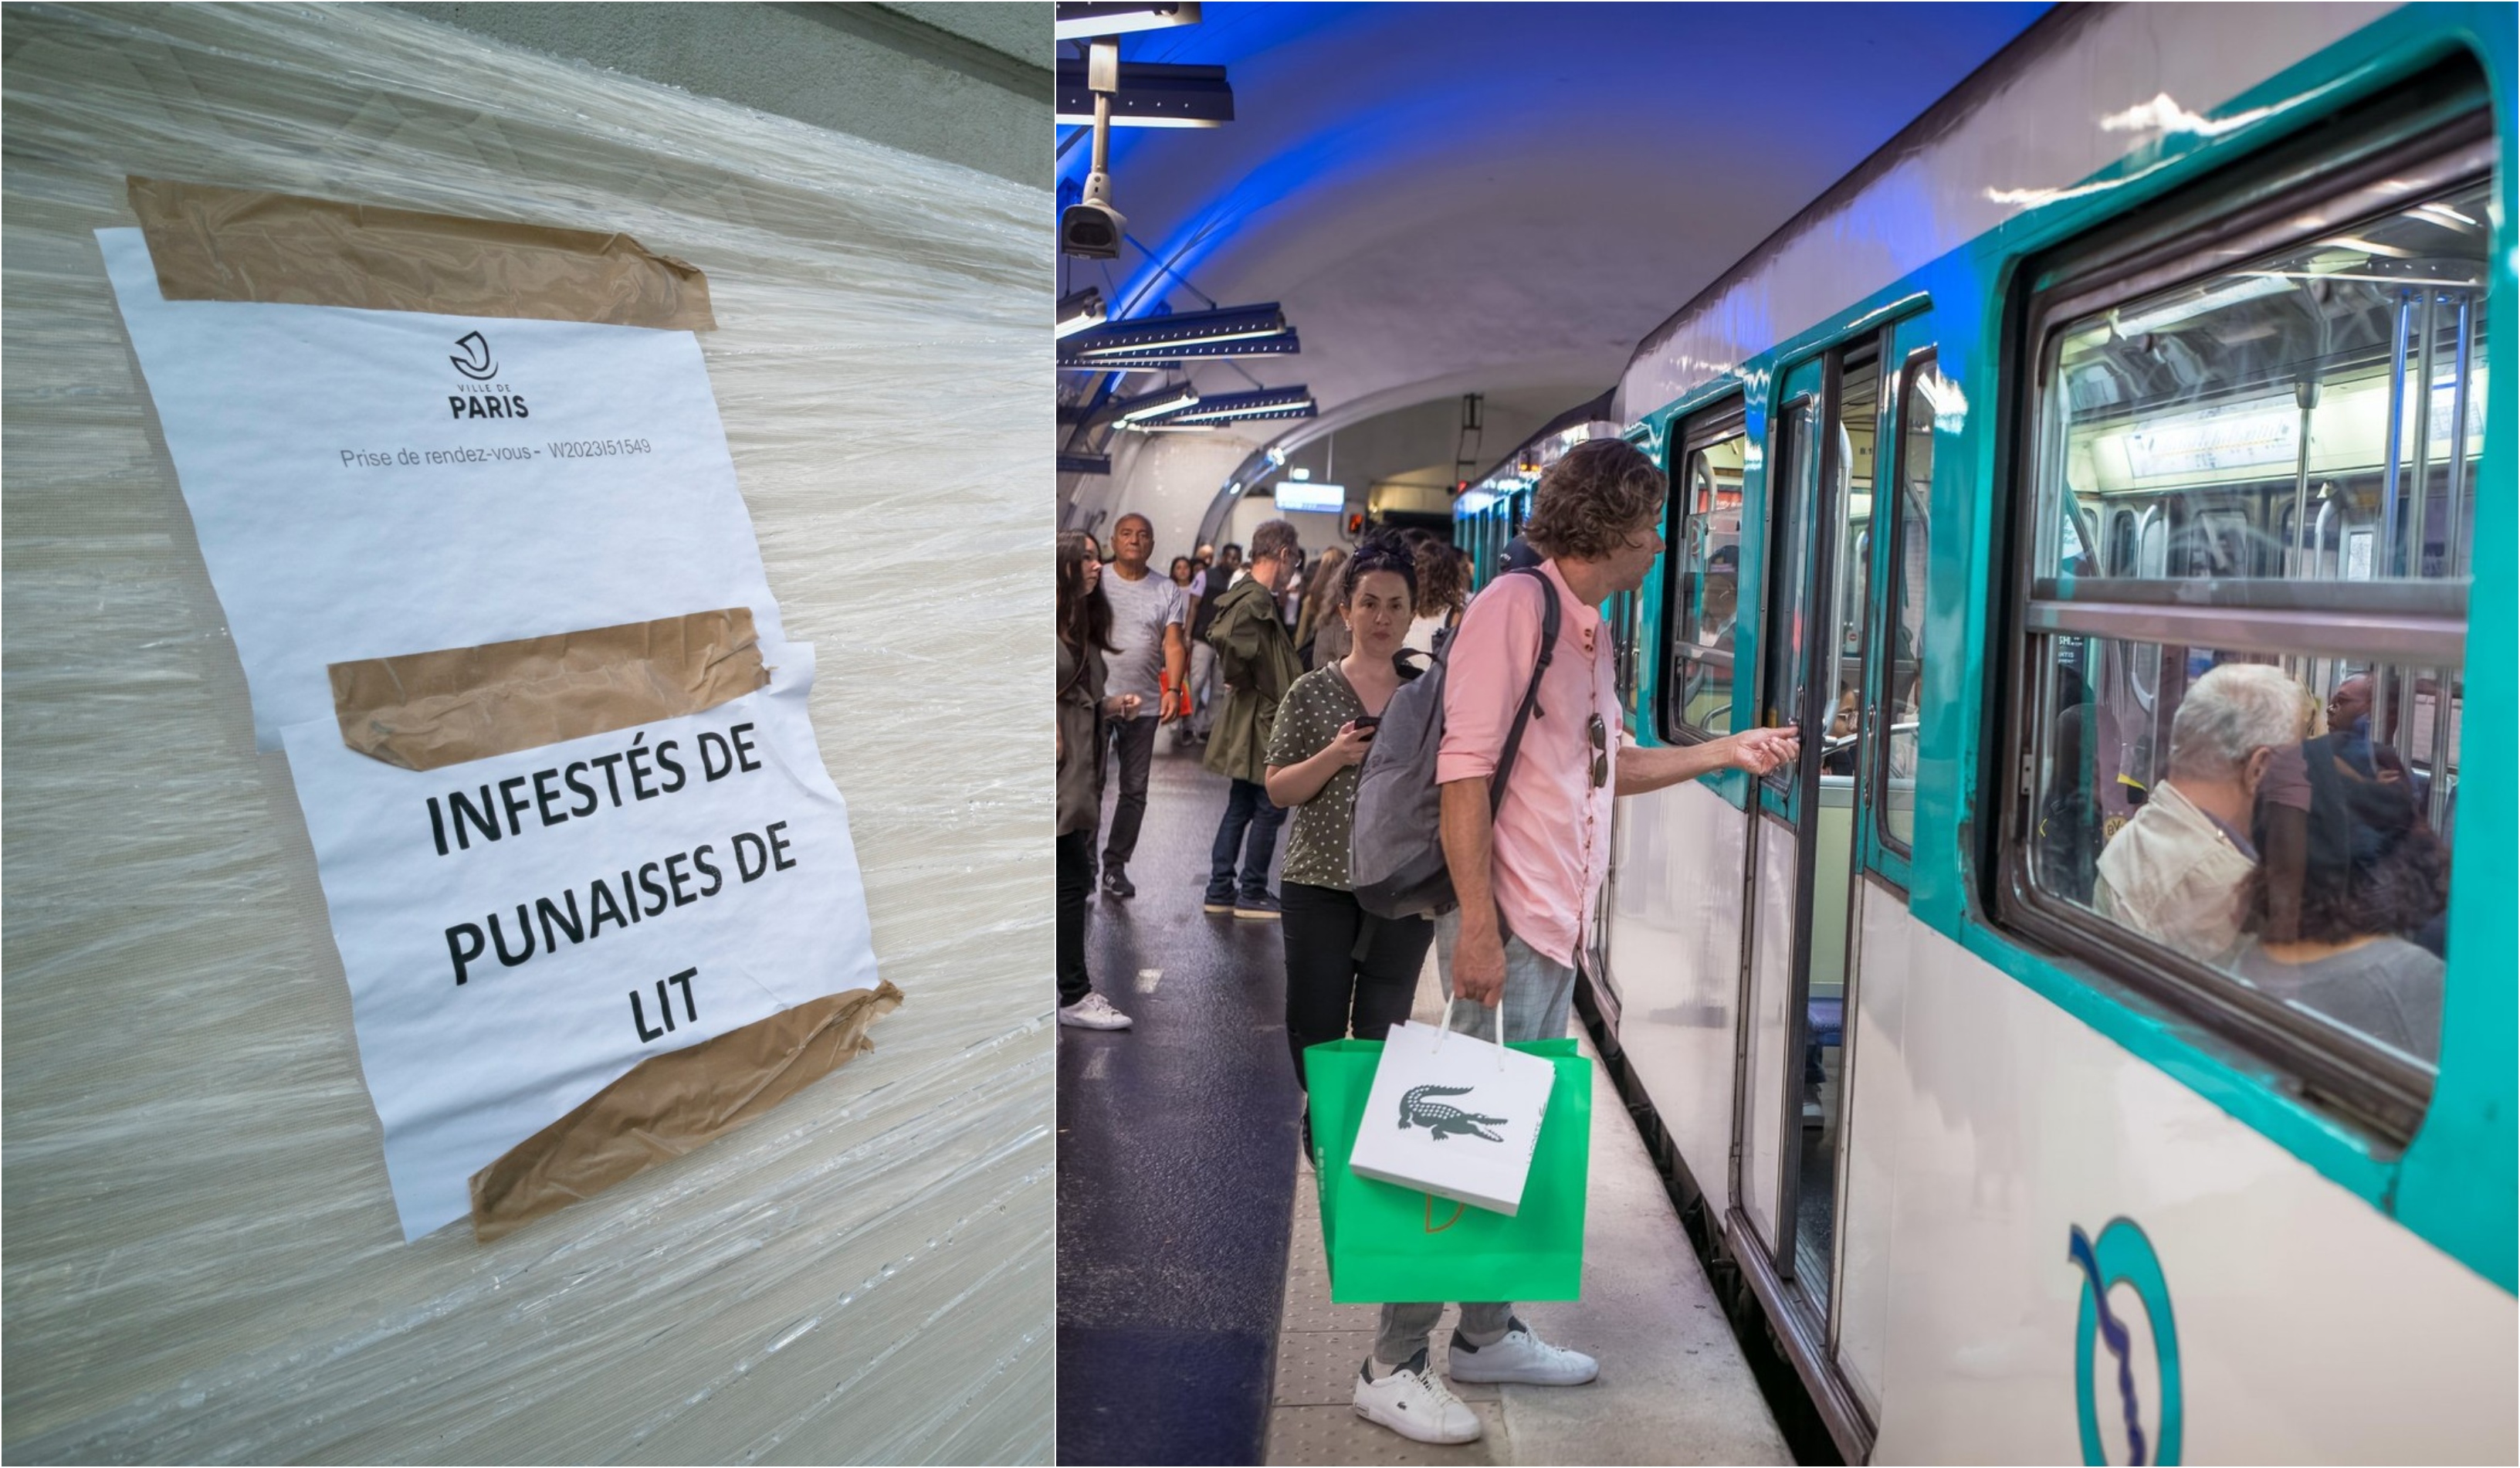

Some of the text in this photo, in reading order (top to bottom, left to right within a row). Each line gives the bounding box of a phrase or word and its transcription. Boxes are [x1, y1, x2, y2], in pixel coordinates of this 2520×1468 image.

[448, 395, 529, 419] PARIS
[340, 449, 392, 468] Prise
[398, 448, 420, 466] de
[425, 446, 531, 464] rendez-vous
[426, 722, 761, 856] INFESTÉS DE
[445, 820, 797, 986] PUNAISES DE
[629, 968, 699, 1043] LIT
